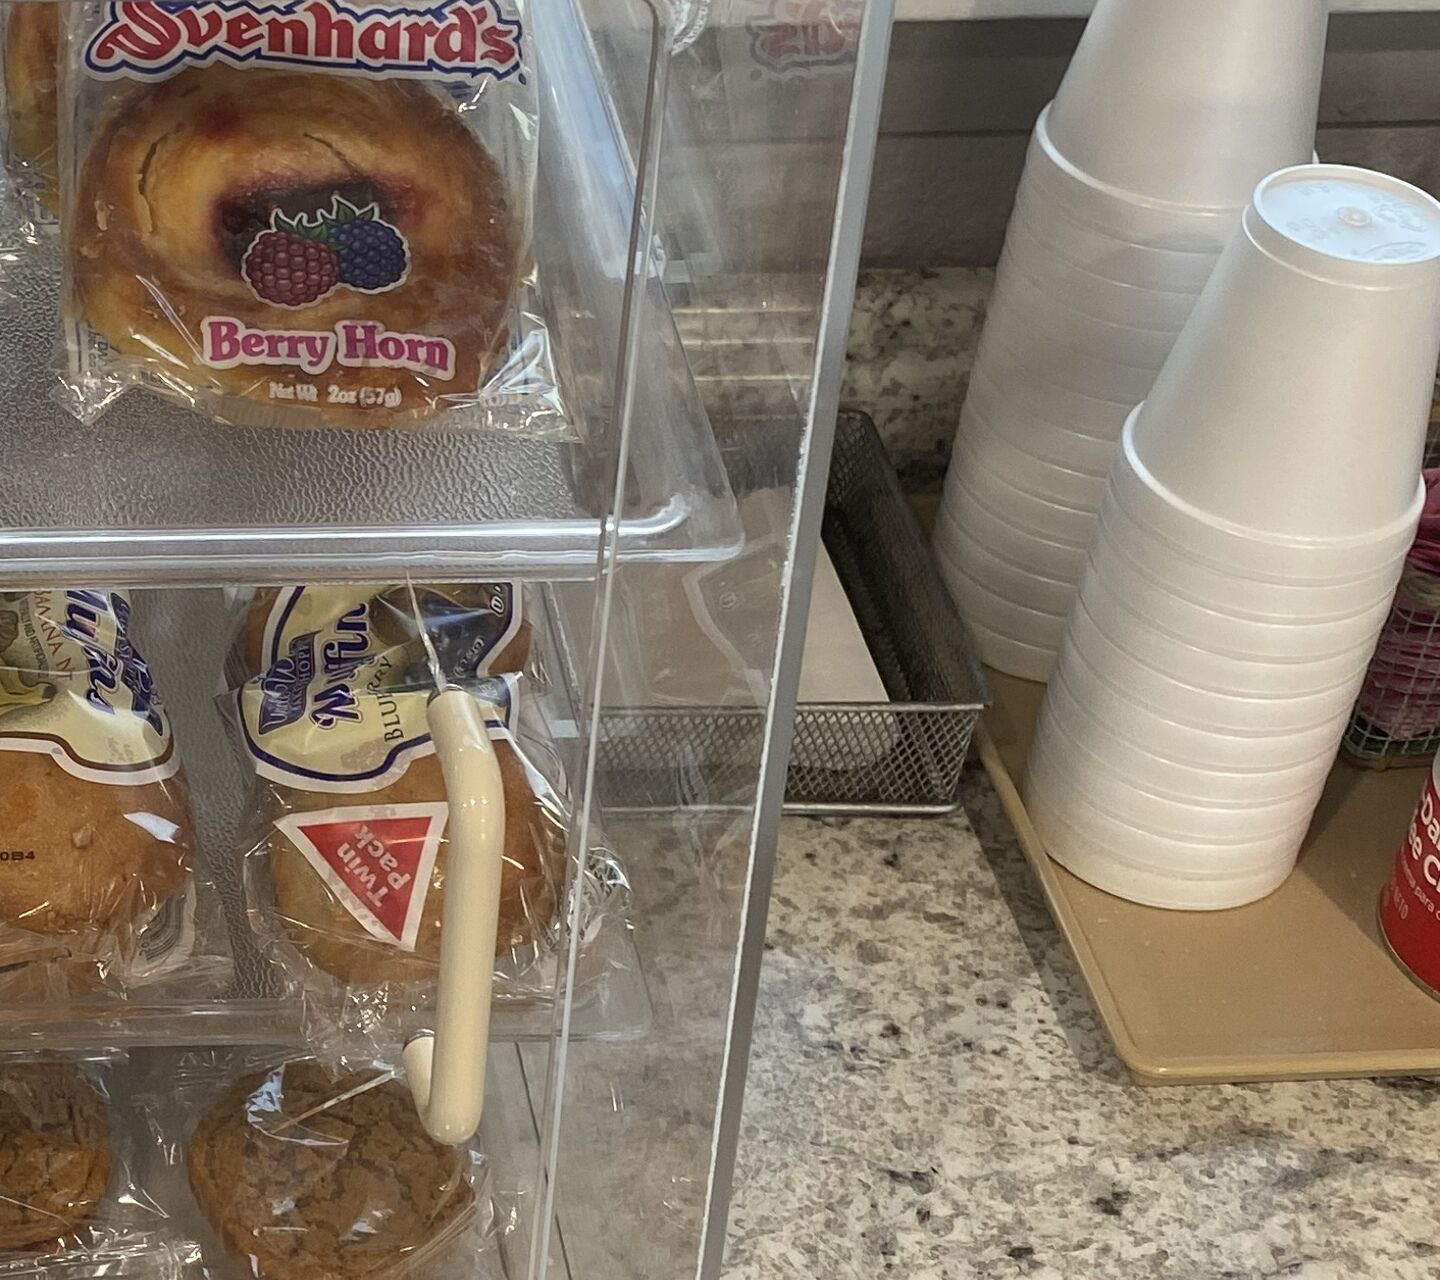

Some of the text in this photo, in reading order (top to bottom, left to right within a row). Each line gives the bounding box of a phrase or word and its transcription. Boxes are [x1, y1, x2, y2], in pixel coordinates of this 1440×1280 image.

[207, 321, 449, 370] Berry Horn
[269, 381, 294, 399] Net
[327, 385, 357, 404] 2oz
[359, 386, 402, 408] (57g)
[337, 843, 384, 909] Twin
[355, 826, 411, 891] Pack
[1414, 886, 1435, 914] para
